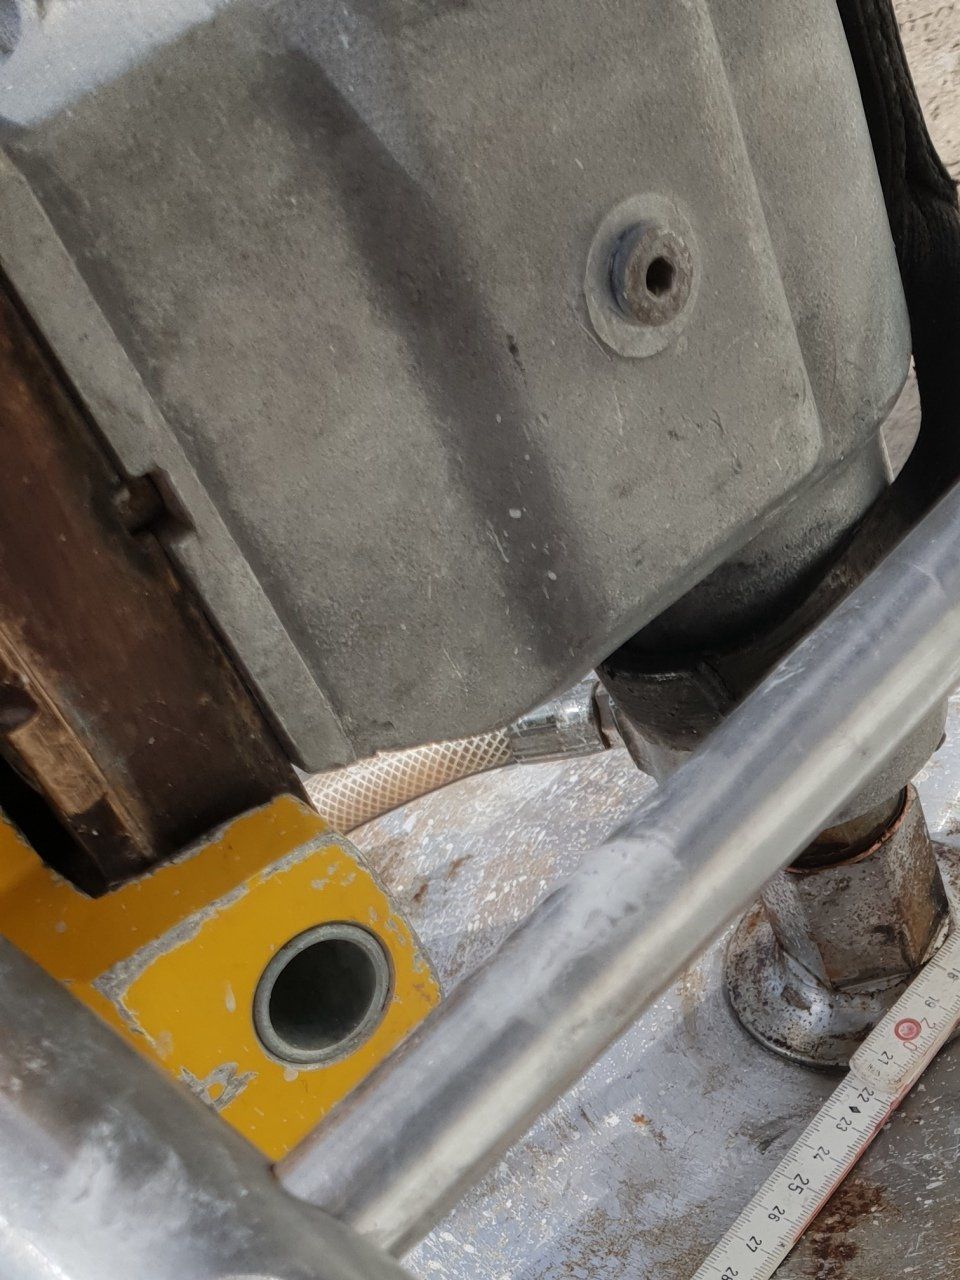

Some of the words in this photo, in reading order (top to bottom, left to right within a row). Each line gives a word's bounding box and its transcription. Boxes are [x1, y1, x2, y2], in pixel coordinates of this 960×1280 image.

[925, 996, 938, 1008] 19
[877, 1051, 894, 1066] 21
[857, 1087, 875, 1103] 22
[836, 1116, 853, 1132] 23
[813, 1146, 830, 1162] 24
[788, 1173, 810, 1195] 25
[768, 1205, 786, 1222] 26
[746, 1235, 763, 1253] 27
